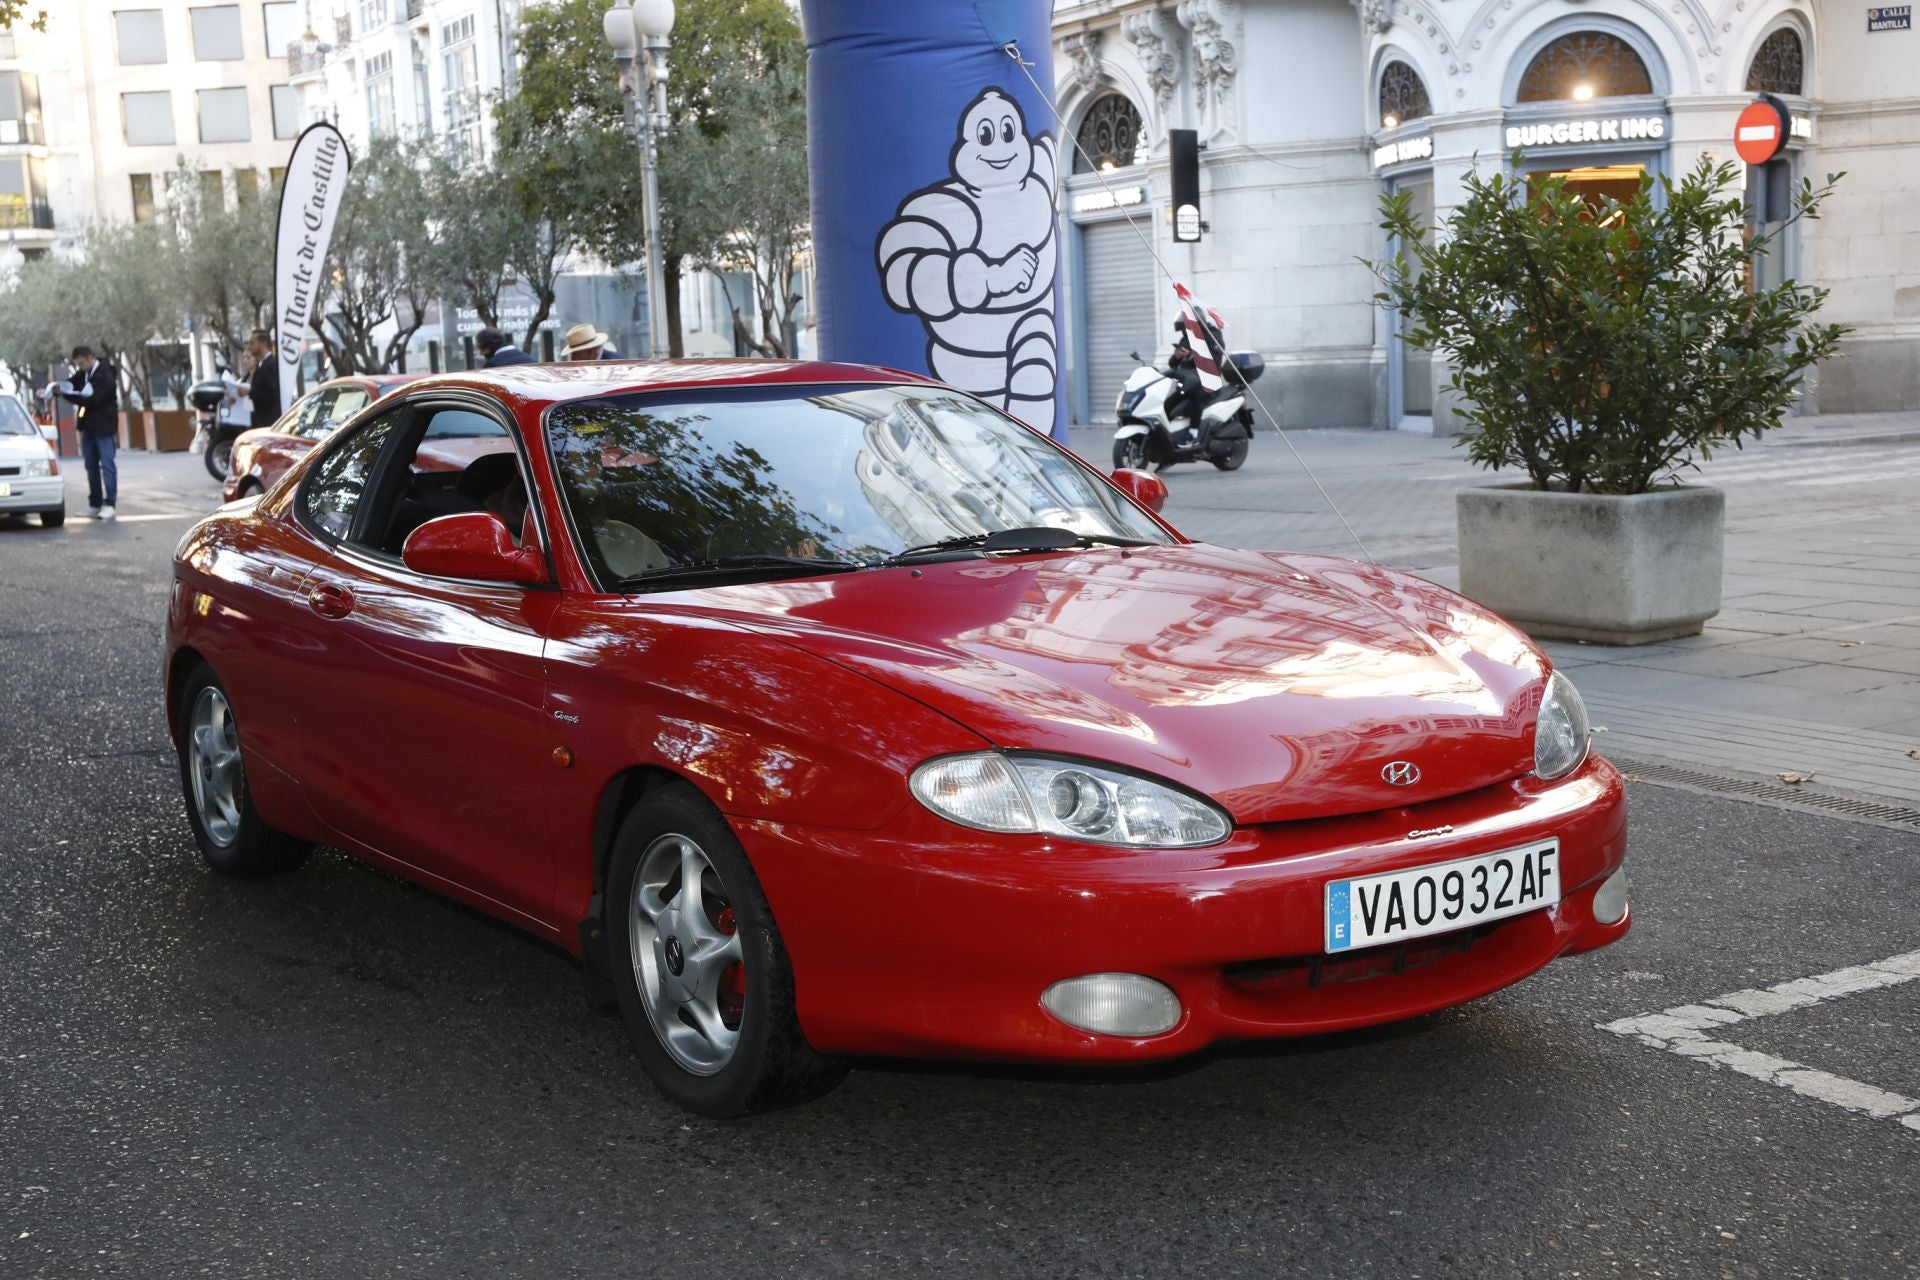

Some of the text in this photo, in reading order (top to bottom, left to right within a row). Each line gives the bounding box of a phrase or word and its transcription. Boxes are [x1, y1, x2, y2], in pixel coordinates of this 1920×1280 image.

[1882, 7, 1910, 17] CALLE
[1871, 19, 1908, 30] MANTILLA
[1506, 117, 1664, 147] BURGER KING
[1178, 222, 1199, 233] KING
[281, 136, 339, 365] El Norte de Castilla
[1358, 847, 1556, 937] VA0932AF
[1335, 923, 1345, 939] E
